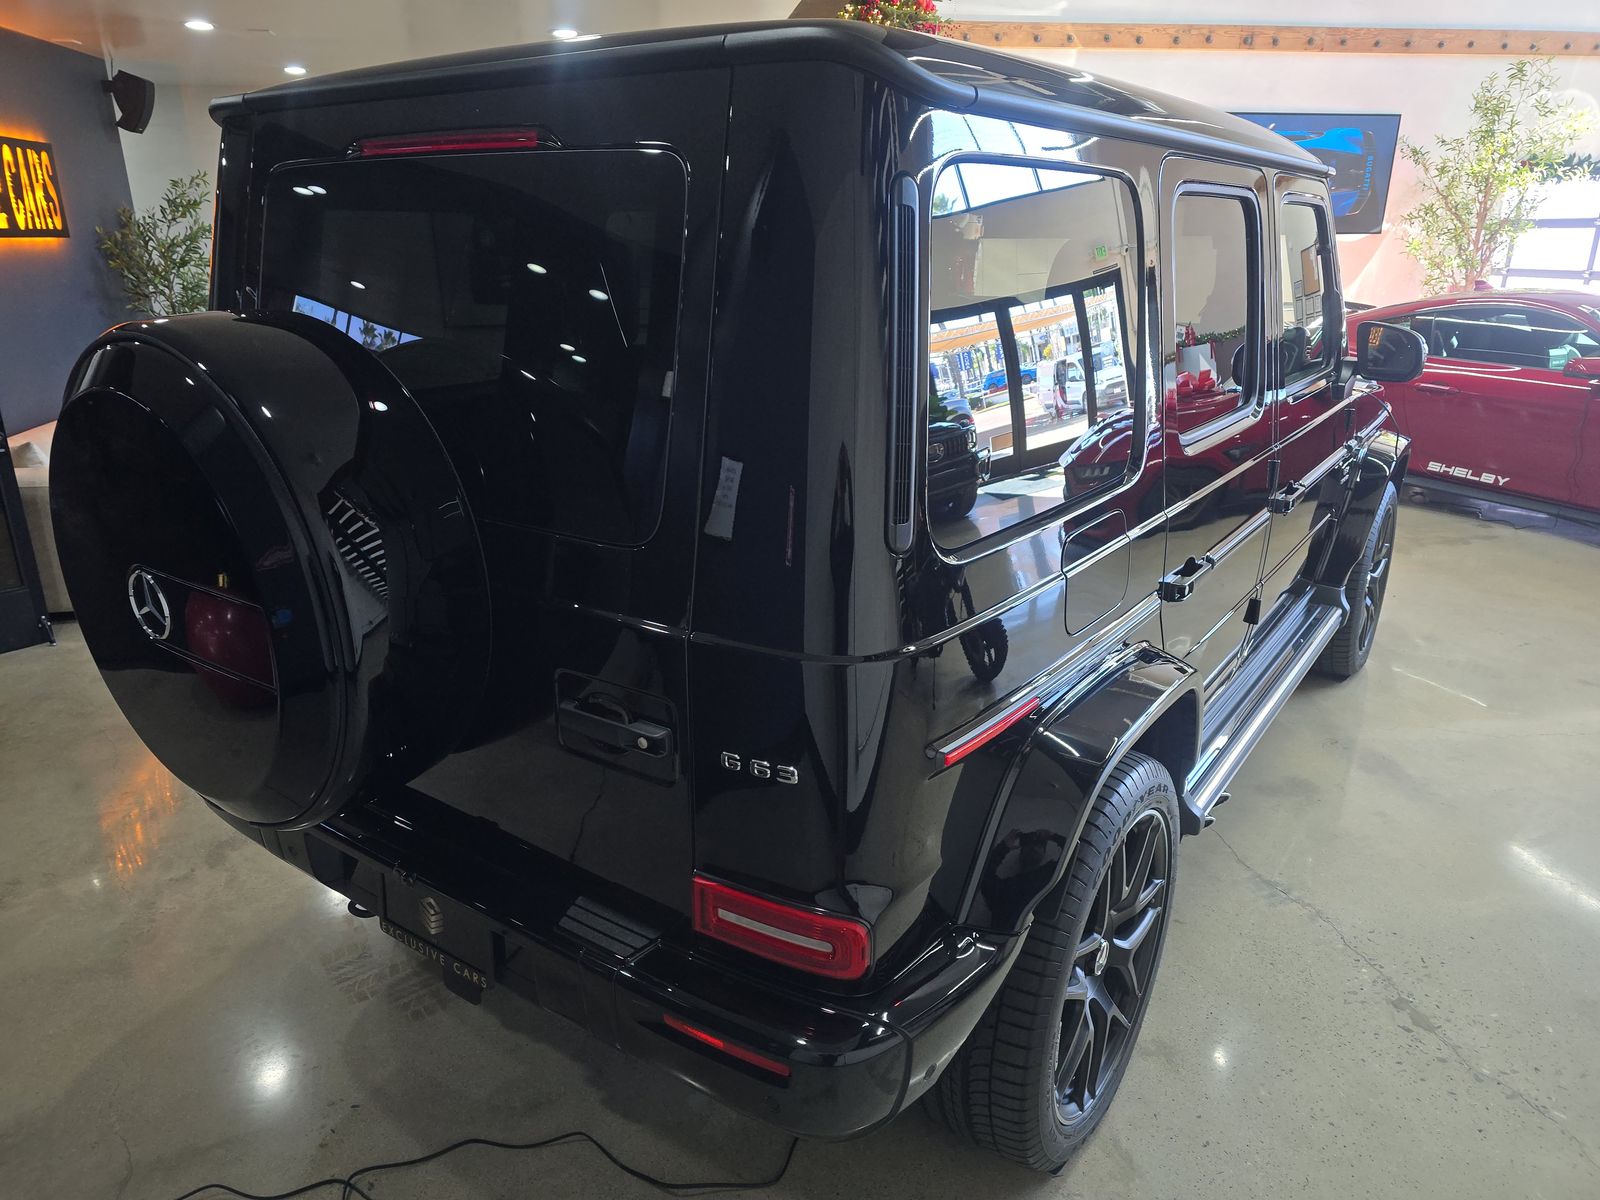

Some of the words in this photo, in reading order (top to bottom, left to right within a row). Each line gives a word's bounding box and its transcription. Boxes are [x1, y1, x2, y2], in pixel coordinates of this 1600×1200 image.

[2, 144, 62, 230] CARS
[1363, 155, 1374, 191] BUGATTI
[1427, 461, 1510, 486] SHELBY
[721, 752, 741, 771] G
[750, 759, 799, 785] 63
[381, 921, 445, 966] EXCLUSIVE
[453, 962, 488, 988] CARS
